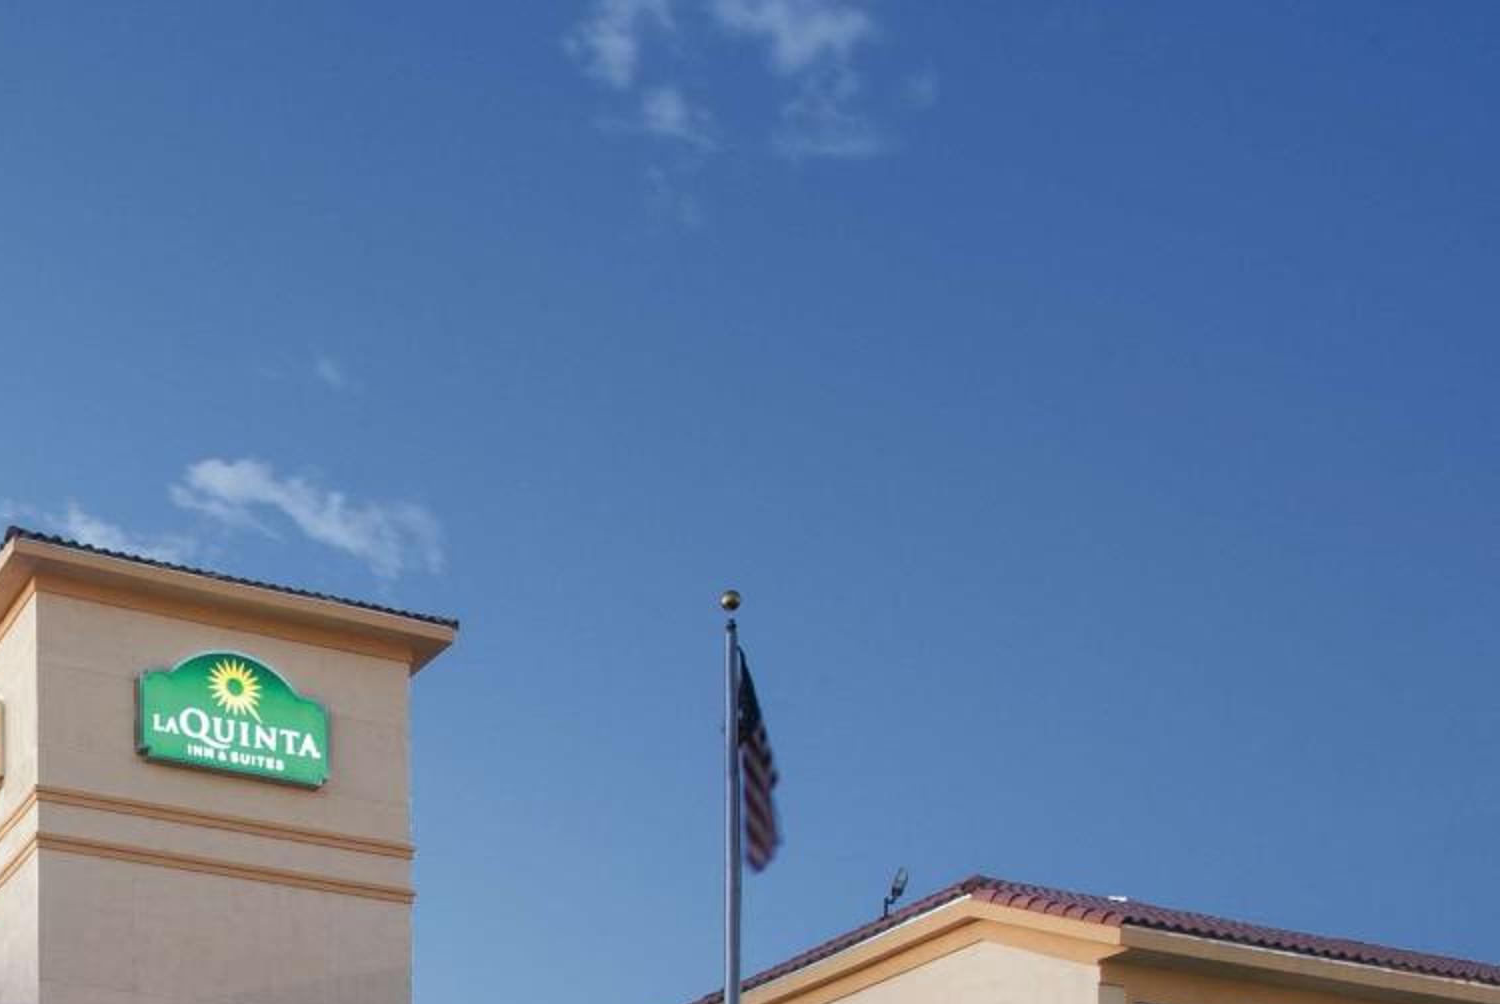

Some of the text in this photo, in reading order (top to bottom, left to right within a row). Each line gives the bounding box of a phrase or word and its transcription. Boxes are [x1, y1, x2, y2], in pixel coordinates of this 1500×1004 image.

[153, 707, 321, 759] LA QUINTA
[188, 744, 285, 771] INN & SUITES
